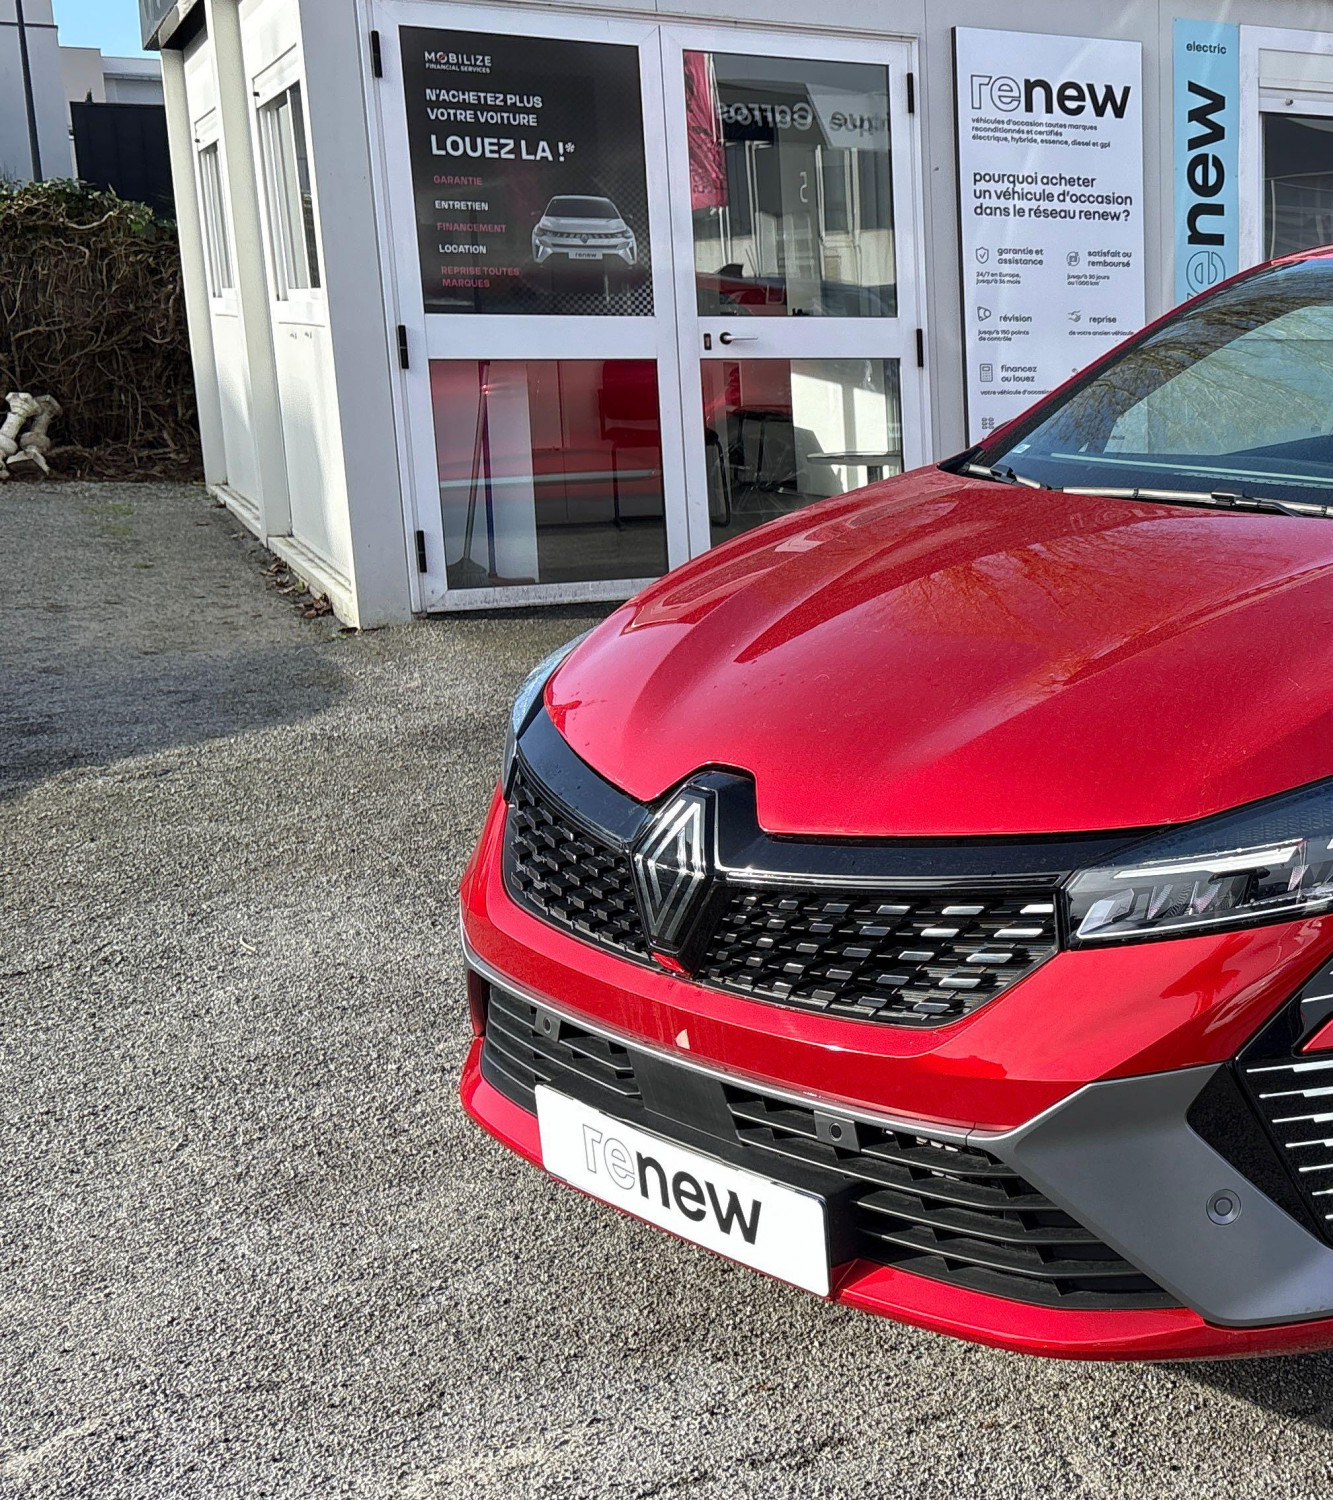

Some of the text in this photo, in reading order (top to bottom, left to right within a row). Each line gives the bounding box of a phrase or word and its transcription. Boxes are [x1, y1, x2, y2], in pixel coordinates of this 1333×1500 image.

[1186, 41, 1227, 55] electric
[424, 51, 492, 66] MOBILIZE
[425, 63, 490, 73] FINANCIAL SERVICES
[425, 88, 542, 108] N'ACHETEZ PLUS
[970, 74, 1131, 118] renew
[427, 107, 537, 126] VOTRE VOITURE
[971, 117, 1098, 132] véhicules d'occasion toutes marques
[971, 126, 1025, 135] reconditionnés
[1035, 129, 1063, 137] certifiés
[971, 134, 1010, 143] électrique,
[1010, 135, 1039, 144] hybride,
[1040, 138, 1070, 147] essence,
[1071, 139, 1091, 147] diesel
[1100, 141, 1111, 149] gpl
[430, 134, 515, 159] LOUEZ
[520, 140, 553, 161] LA
[433, 175, 483, 186] GARANTIE
[973, 171, 1096, 187] pourquoi acheter
[973, 187, 1133, 206] un véhicule d'occasion
[434, 200, 488, 211] ENTRETIEN
[974, 203, 1010, 217] dans
[1013, 204, 1025, 218] le
[1028, 204, 1076, 219] réseau
[436, 222, 507, 233] FINANCEMENT
[439, 244, 487, 254] LOCATION
[997, 246, 1034, 256] garantie
[1088, 249, 1121, 257] satisfait
[997, 256, 1043, 265] assistance
[441, 266, 520, 276] REPRISE TOUTES
[442, 278, 490, 288] MARQUES
[999, 314, 1032, 323] révision
[1089, 316, 1117, 324] reprise
[1001, 364, 1037, 373] financez
[1013, 375, 1035, 383] louez
[582, 1124, 762, 1245] renew
